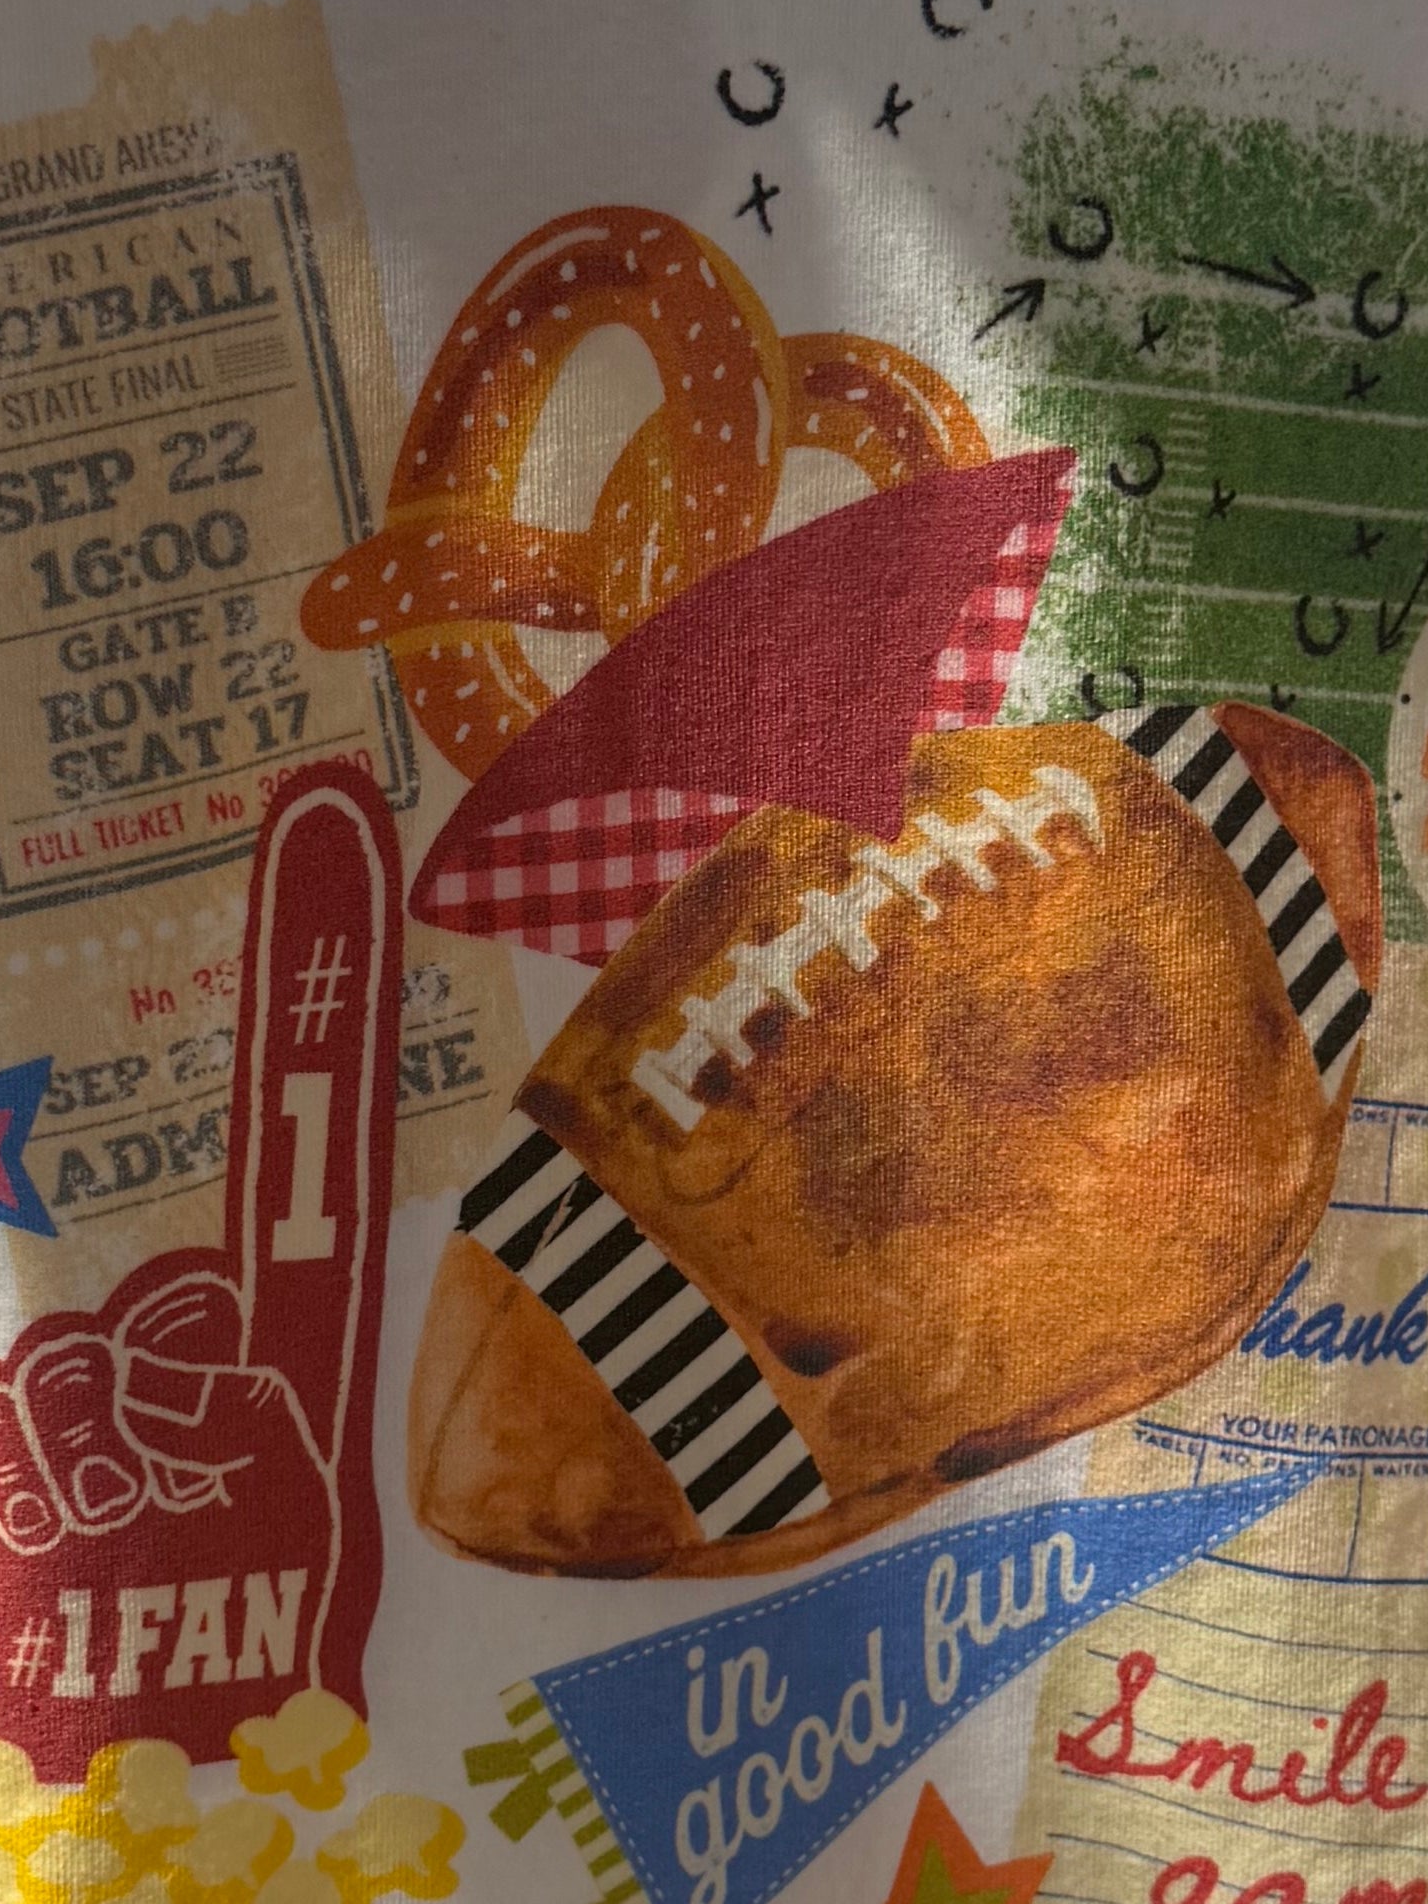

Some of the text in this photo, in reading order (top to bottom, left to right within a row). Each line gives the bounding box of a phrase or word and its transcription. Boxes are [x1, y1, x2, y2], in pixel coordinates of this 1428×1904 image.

[0, 353, 206, 433] STATE FINAL
[160, 419, 263, 495] 22
[30, 508, 252, 611] 16:00
[59, 604, 209, 674] GATE
[39, 639, 301, 744] ROW 22
[48, 713, 226, 798] SEAT
[248, 692, 310, 752] 17
[22, 792, 245, 867] FULL TICKET No
[46, 1054, 152, 1116] SEP
[1133, 1428, 1198, 1458] TABLE
[1222, 1412, 1296, 1445] YOUR
[9, 1567, 309, 1698] #1 FAN
[924, 1532, 1094, 1708] fun
[685, 1645, 788, 1758] in
